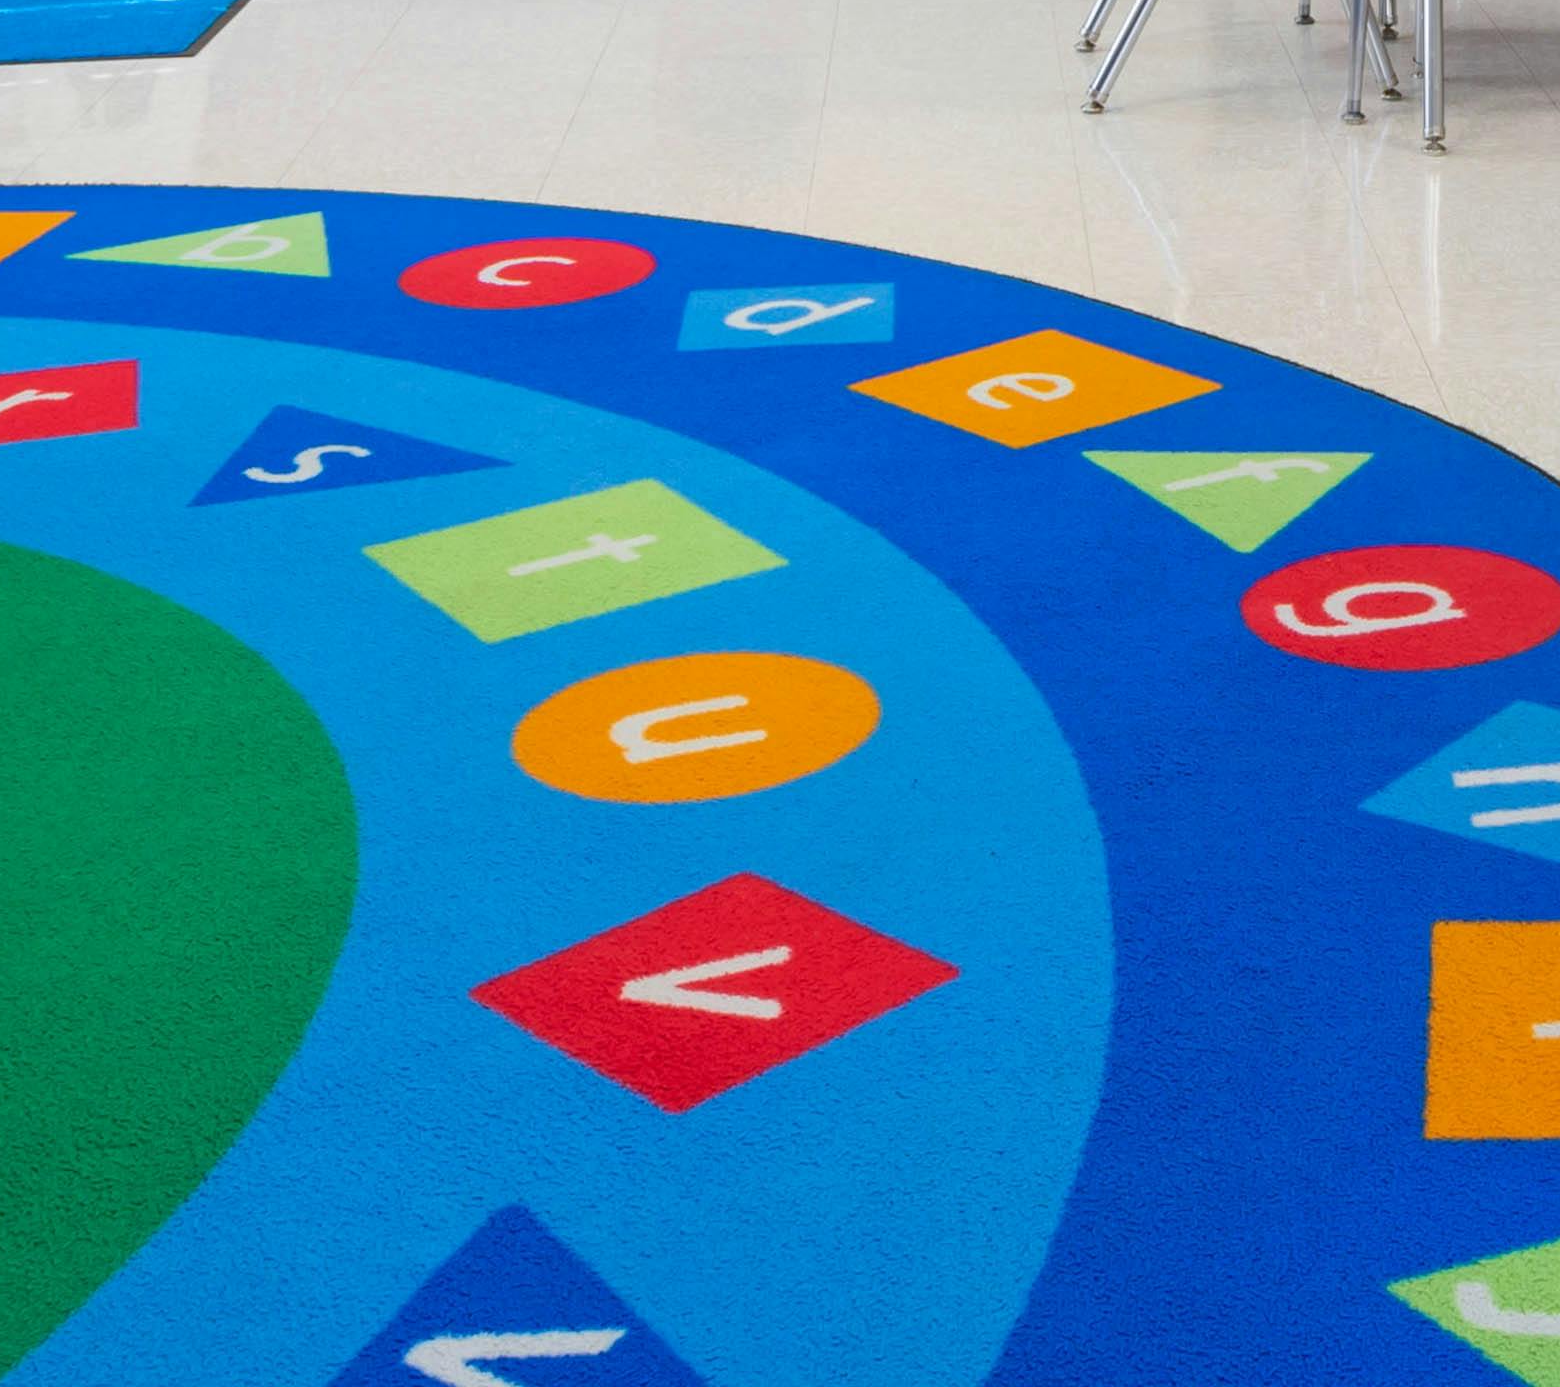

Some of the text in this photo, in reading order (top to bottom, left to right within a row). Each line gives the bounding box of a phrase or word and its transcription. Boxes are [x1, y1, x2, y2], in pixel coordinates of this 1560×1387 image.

[178, 223, 292, 262] b
[477, 255, 577, 287] c
[724, 296, 875, 336] d
[966, 371, 1074, 411] e
[243, 443, 372, 484] s
[1163, 457, 1330, 494] f
[509, 532, 659, 577] t
[1275, 582, 1466, 637] g
[610, 694, 767, 763] u
[620, 945, 792, 1020] v
